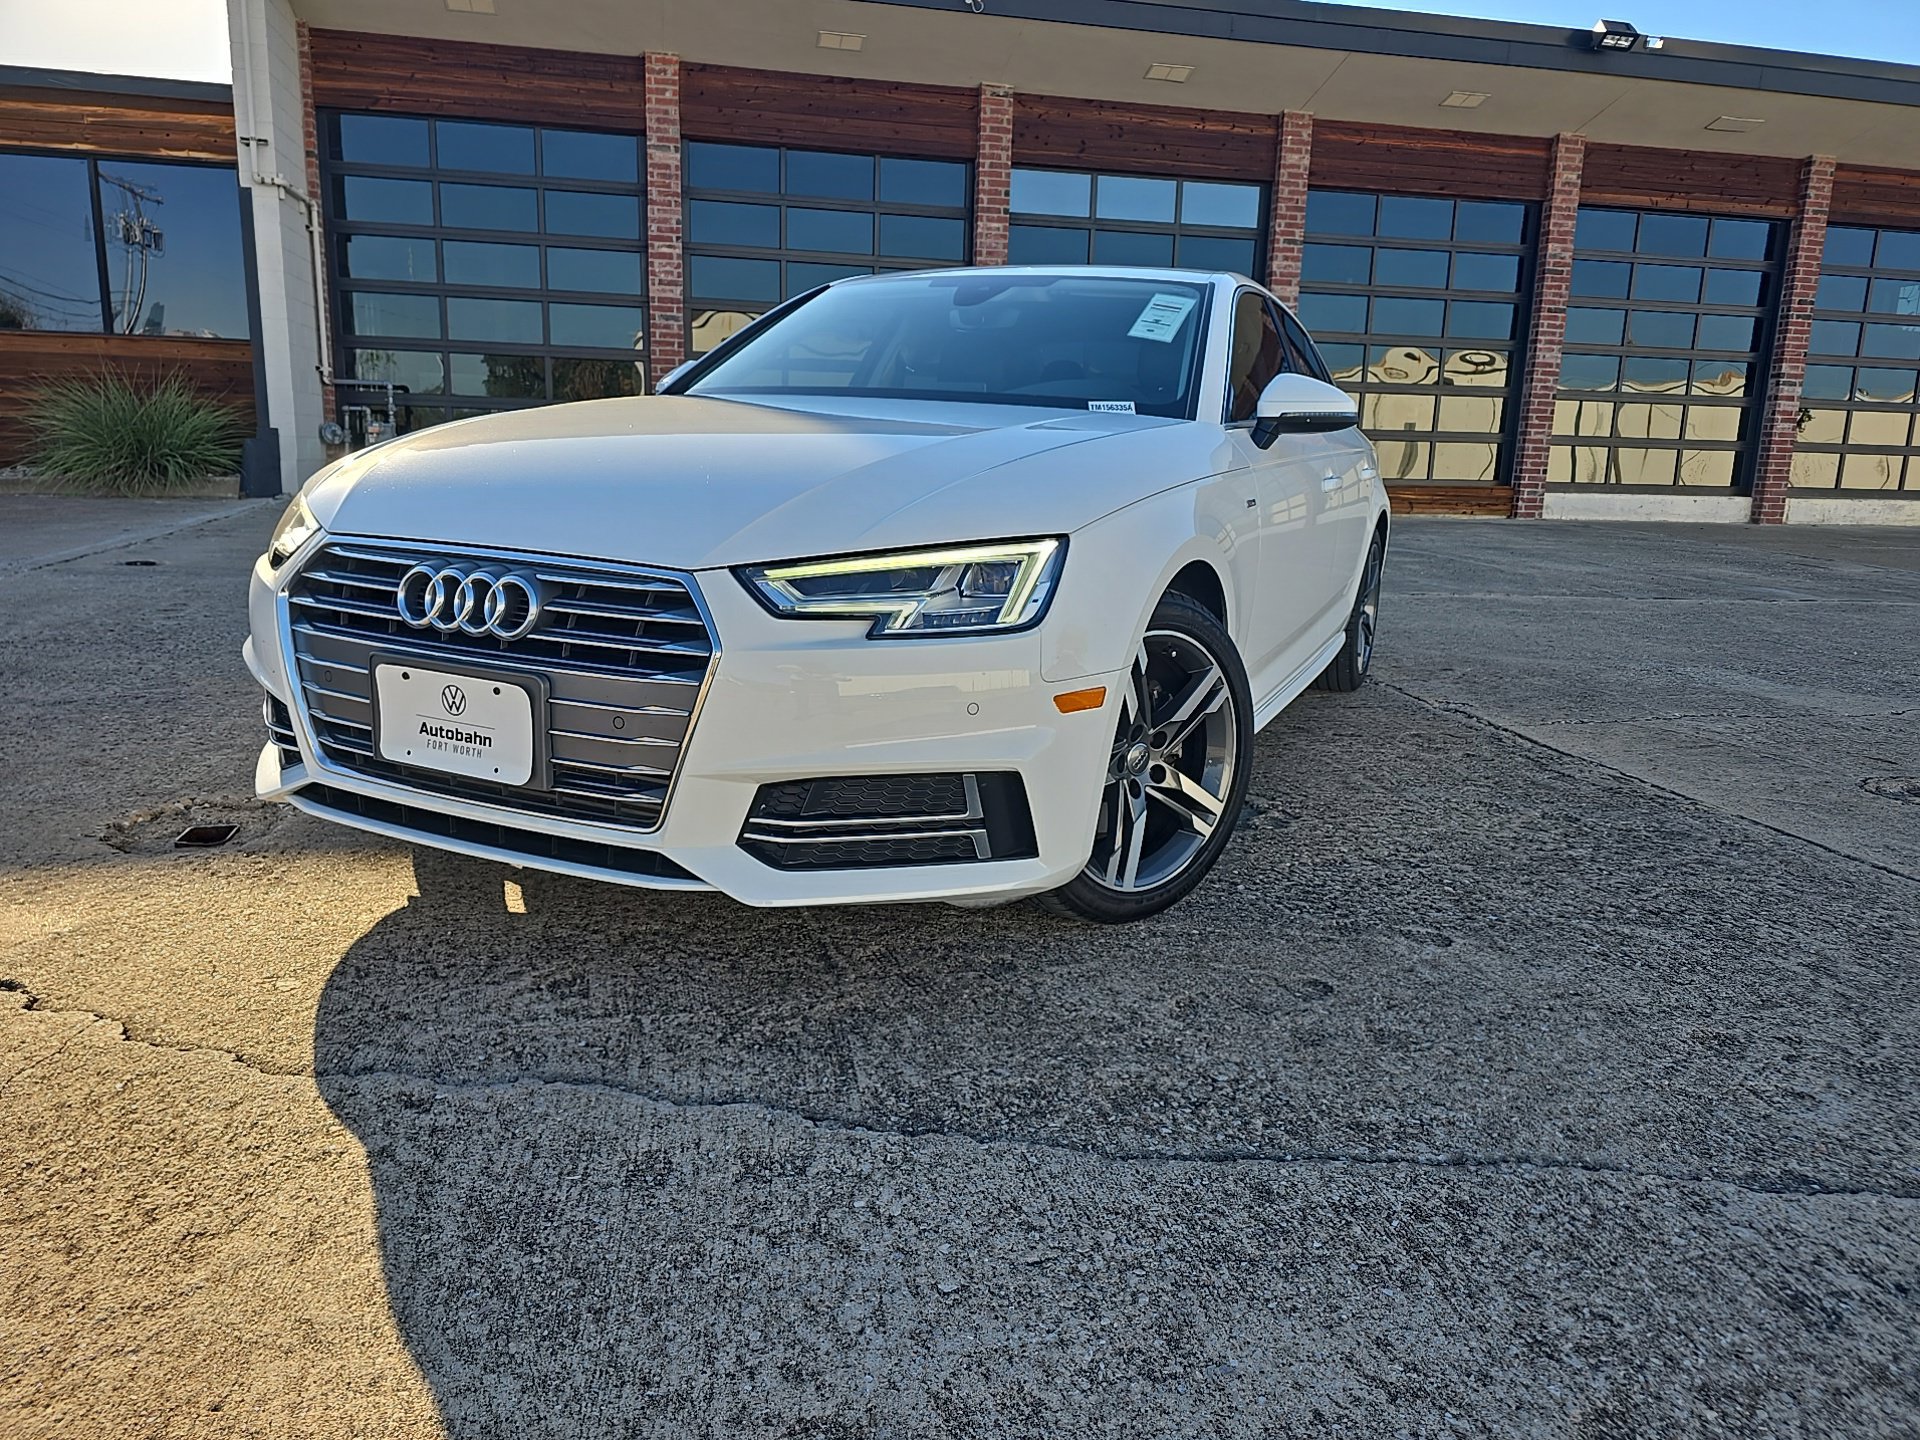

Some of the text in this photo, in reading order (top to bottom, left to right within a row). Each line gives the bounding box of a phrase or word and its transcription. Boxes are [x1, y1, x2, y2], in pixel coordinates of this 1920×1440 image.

[419, 721, 492, 748] Autobahn
[426, 738, 483, 759] FORT WORTH
